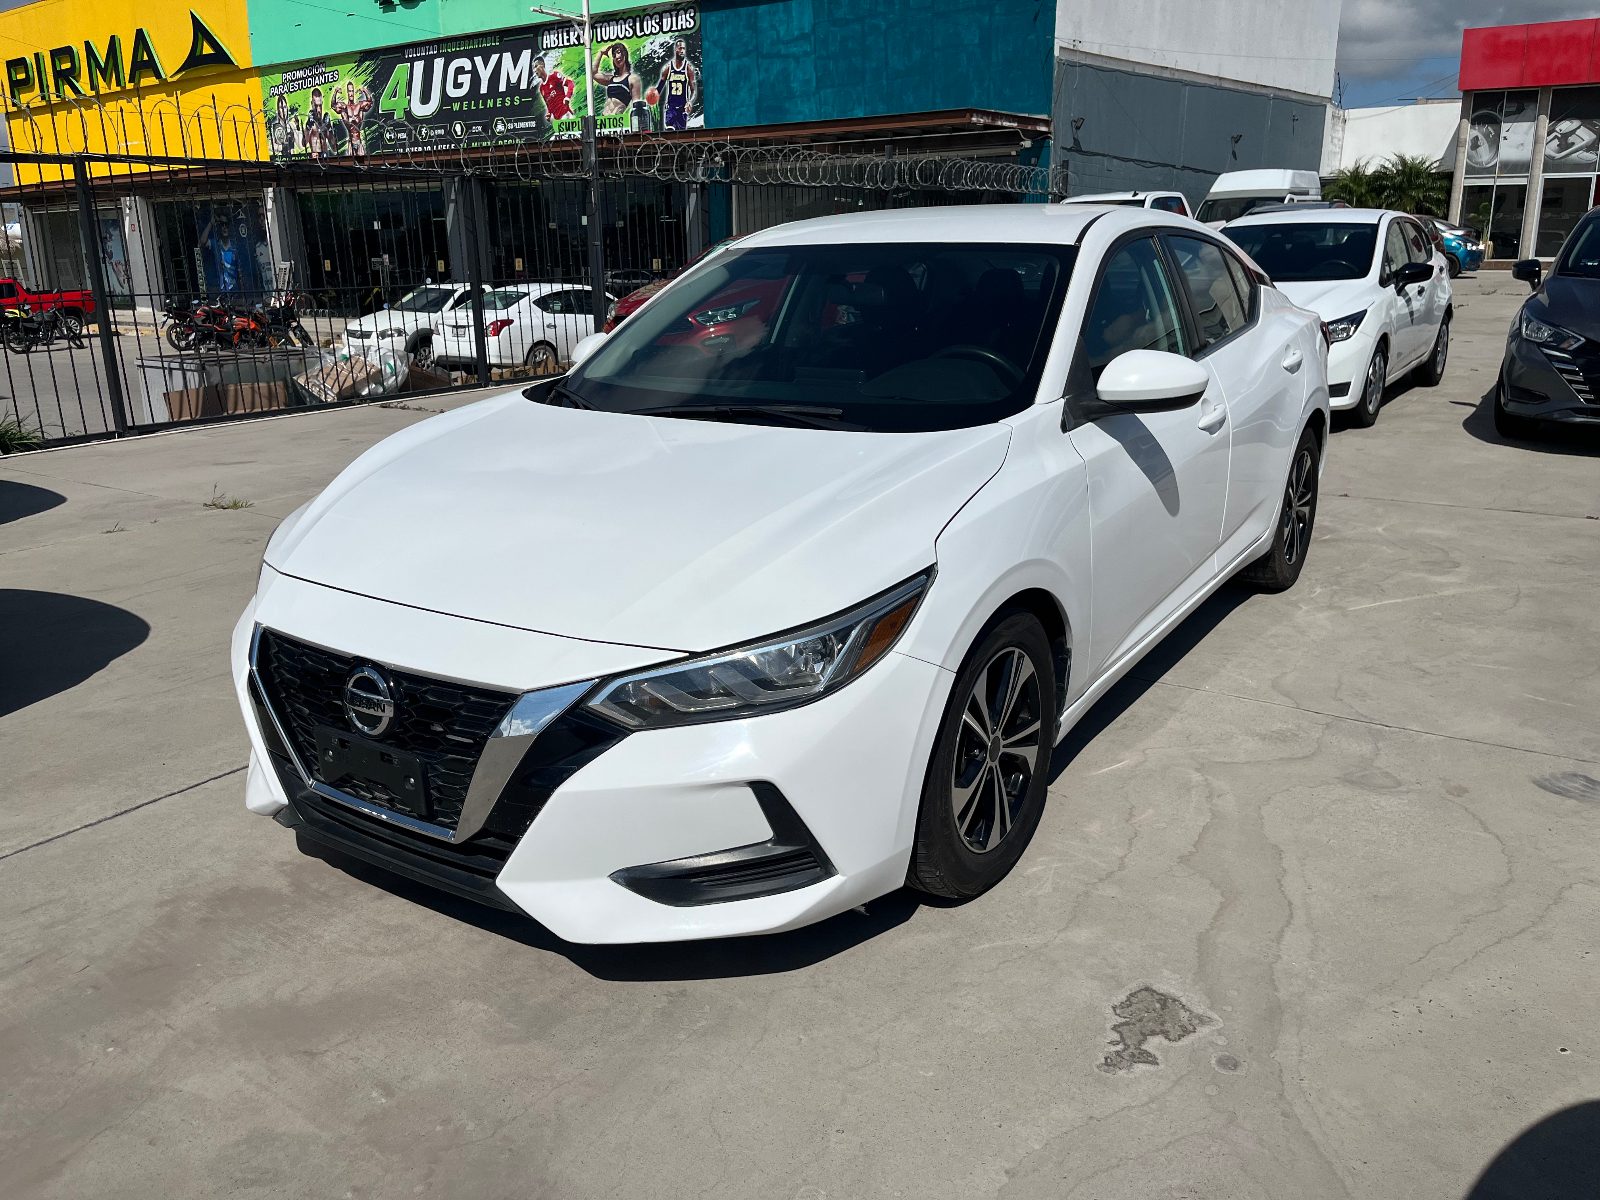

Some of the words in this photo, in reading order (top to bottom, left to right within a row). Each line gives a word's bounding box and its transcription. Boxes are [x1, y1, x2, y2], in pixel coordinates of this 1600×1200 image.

[543, 26, 593, 49] ABIERT
[595, 19, 633, 41] TODOS
[636, 14, 660, 36] LOS
[662, 8, 695, 31] DIAS
[404, 45, 438, 58] VOLUNTAD
[439, 35, 500, 53] INQUEBRANTABLE
[6, 28, 167, 108] PIRMA
[282, 63, 326, 82] PROMOCIÓN
[270, 83, 289, 96] PARA
[289, 71, 339, 92] ESTUDIANTES
[671, 82, 683, 95] 23
[452, 96, 521, 111] WELLNESS
[559, 117, 624, 132] SUPLENTOS
[350, 694, 386, 713] SSAN
